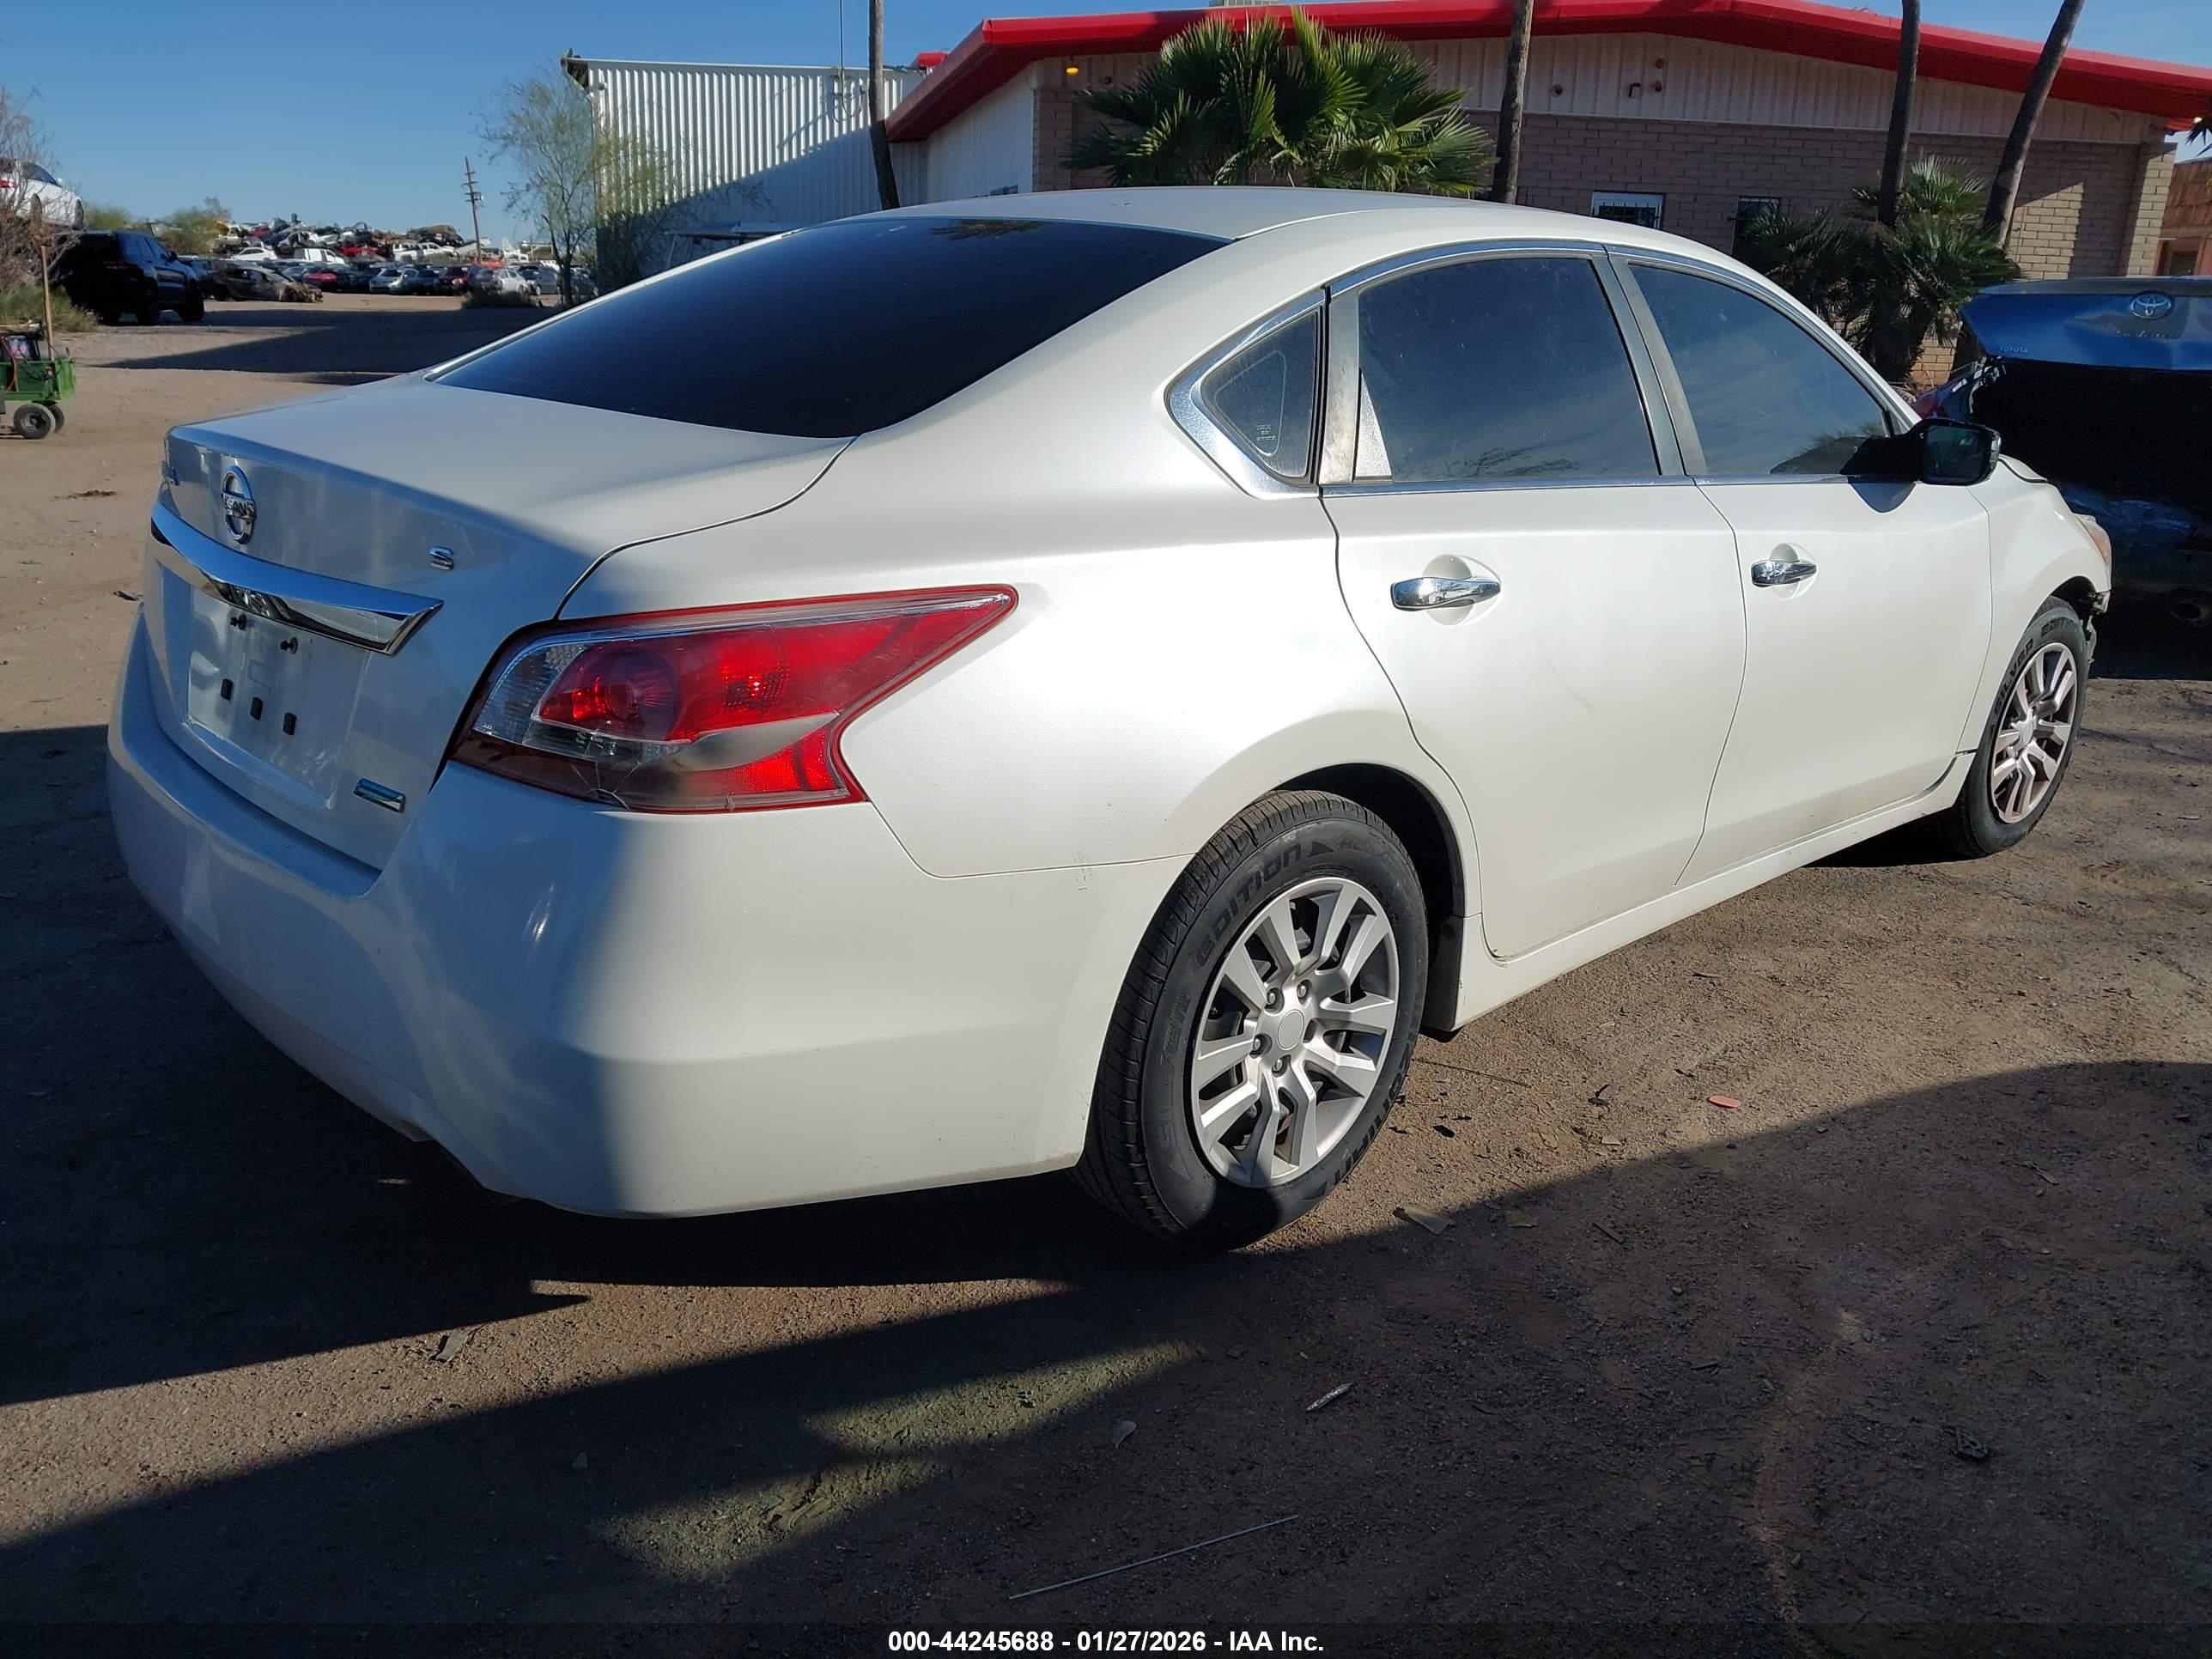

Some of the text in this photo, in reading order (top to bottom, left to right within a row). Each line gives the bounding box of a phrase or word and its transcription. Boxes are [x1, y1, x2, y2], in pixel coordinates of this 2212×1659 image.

[2000, 345, 2028, 354] TOYOTA
[429, 546, 454, 570] S
[1195, 842, 1302, 967] EDITION
